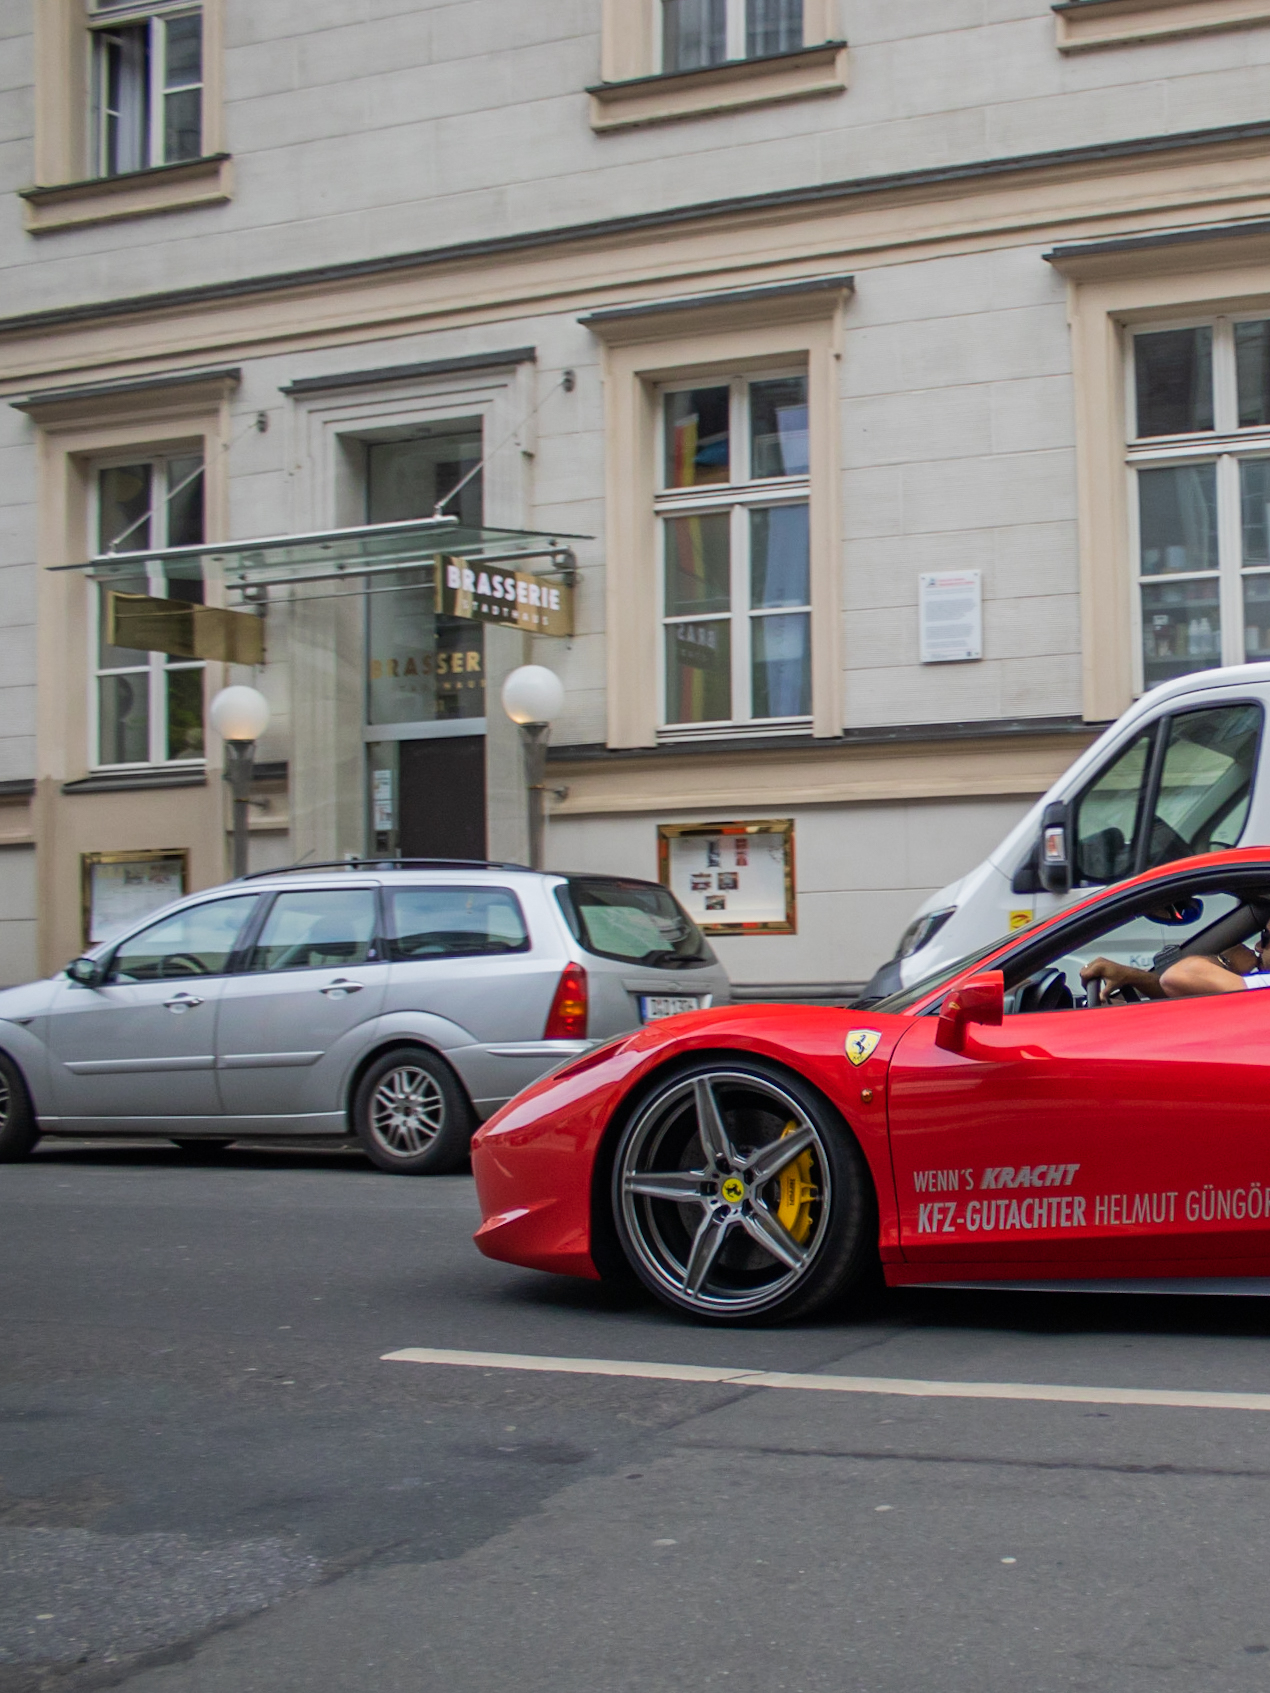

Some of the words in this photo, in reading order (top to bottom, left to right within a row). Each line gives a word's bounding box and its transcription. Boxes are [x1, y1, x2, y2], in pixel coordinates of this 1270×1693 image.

[447, 564, 560, 611] BRASSERIE
[979, 1164, 1081, 1190] KRACHT
[917, 1196, 1087, 1234] KFZ-GUTACHTER
[1095, 1191, 1178, 1226] HELMUT
